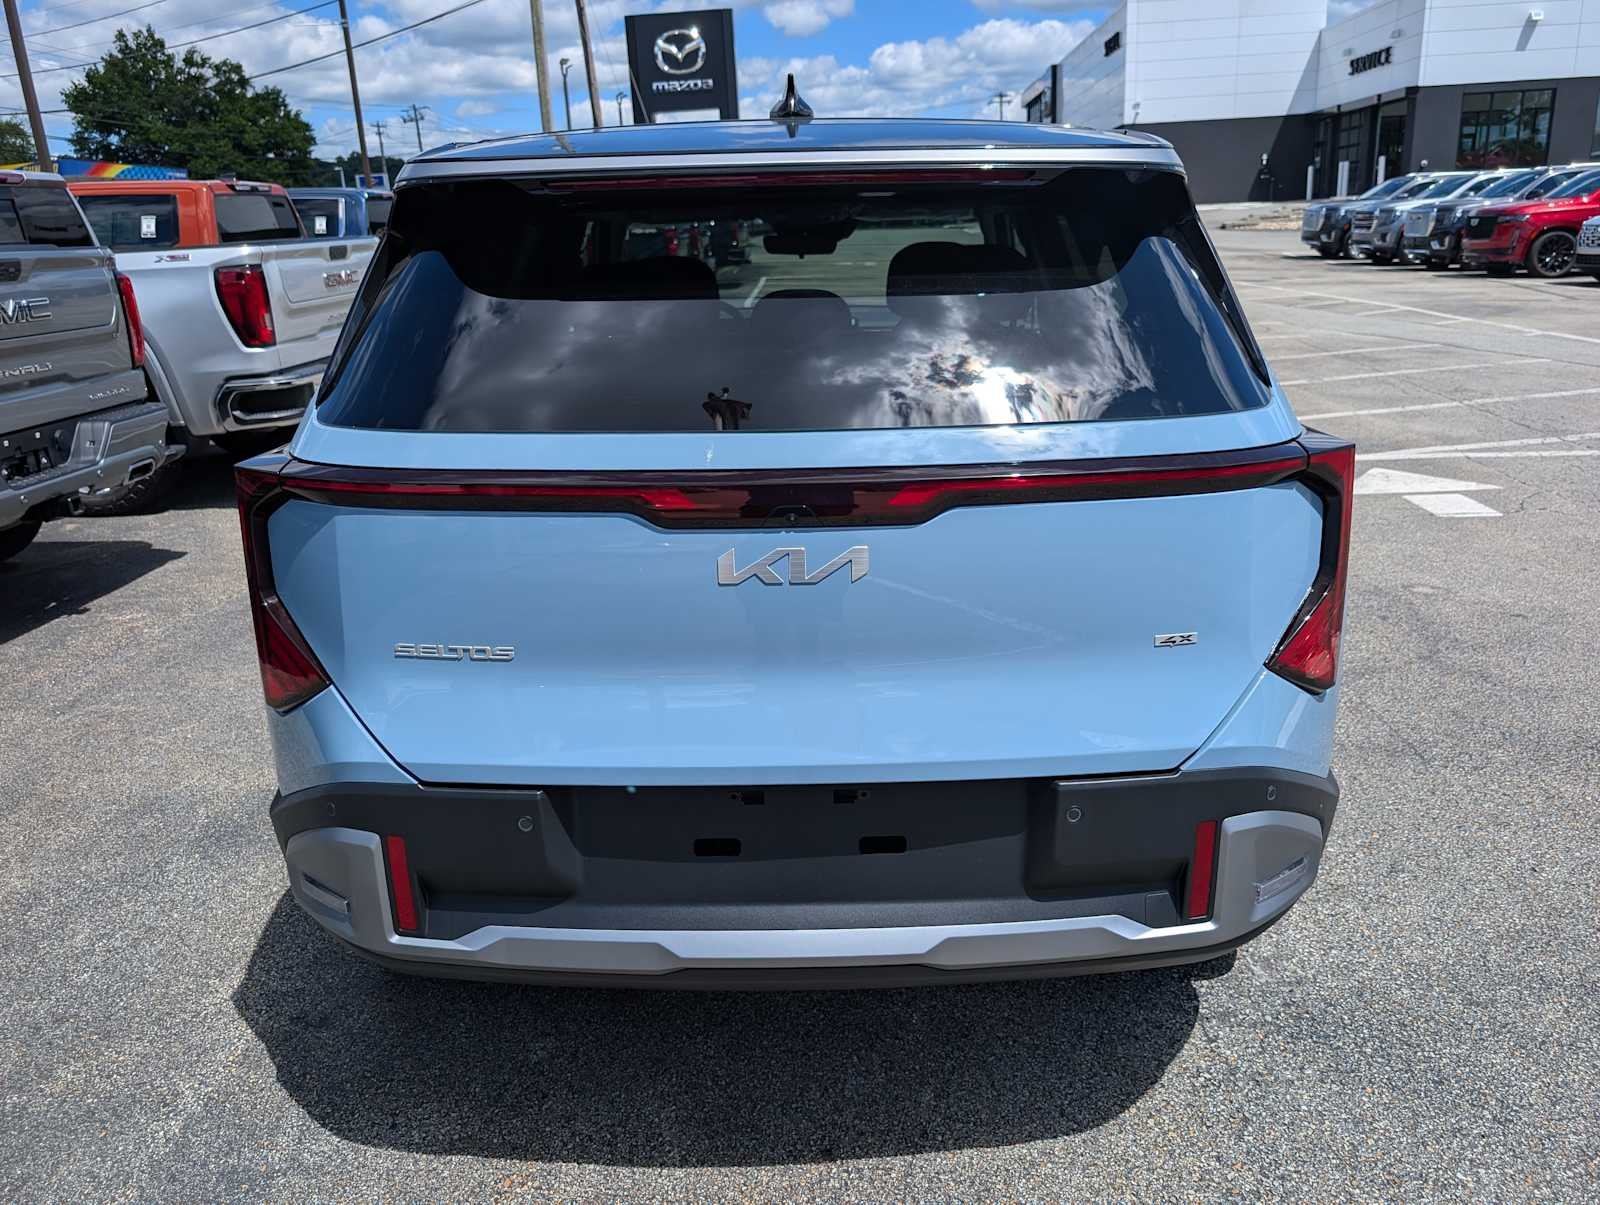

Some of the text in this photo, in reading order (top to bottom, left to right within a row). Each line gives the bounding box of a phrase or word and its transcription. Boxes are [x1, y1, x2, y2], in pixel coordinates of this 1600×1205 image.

[1348, 46, 1392, 76] SERVICE
[651, 78, 714, 92] mazda
[716, 545, 870, 586] KIA
[393, 642, 515, 662] SELTOS
